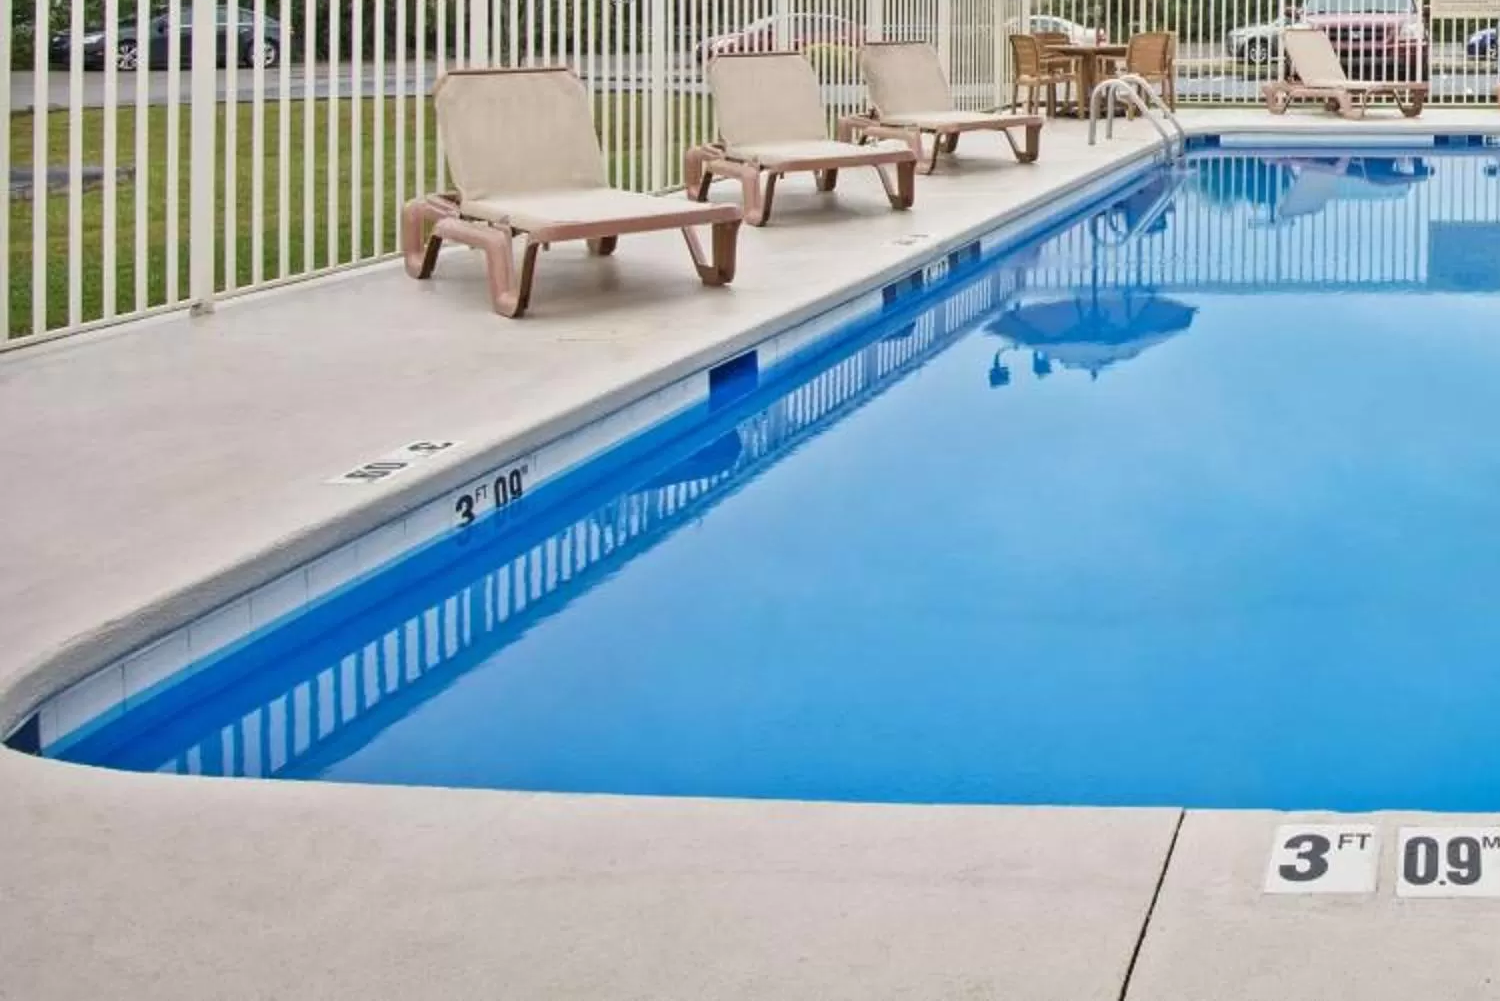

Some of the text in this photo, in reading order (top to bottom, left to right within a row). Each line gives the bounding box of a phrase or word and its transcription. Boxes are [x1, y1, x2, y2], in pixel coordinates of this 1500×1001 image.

[455, 494, 476, 528] 3
[1278, 833, 1331, 882] 3
[1337, 832, 1373, 850] FT
[1403, 835, 1482, 886] 0.9
